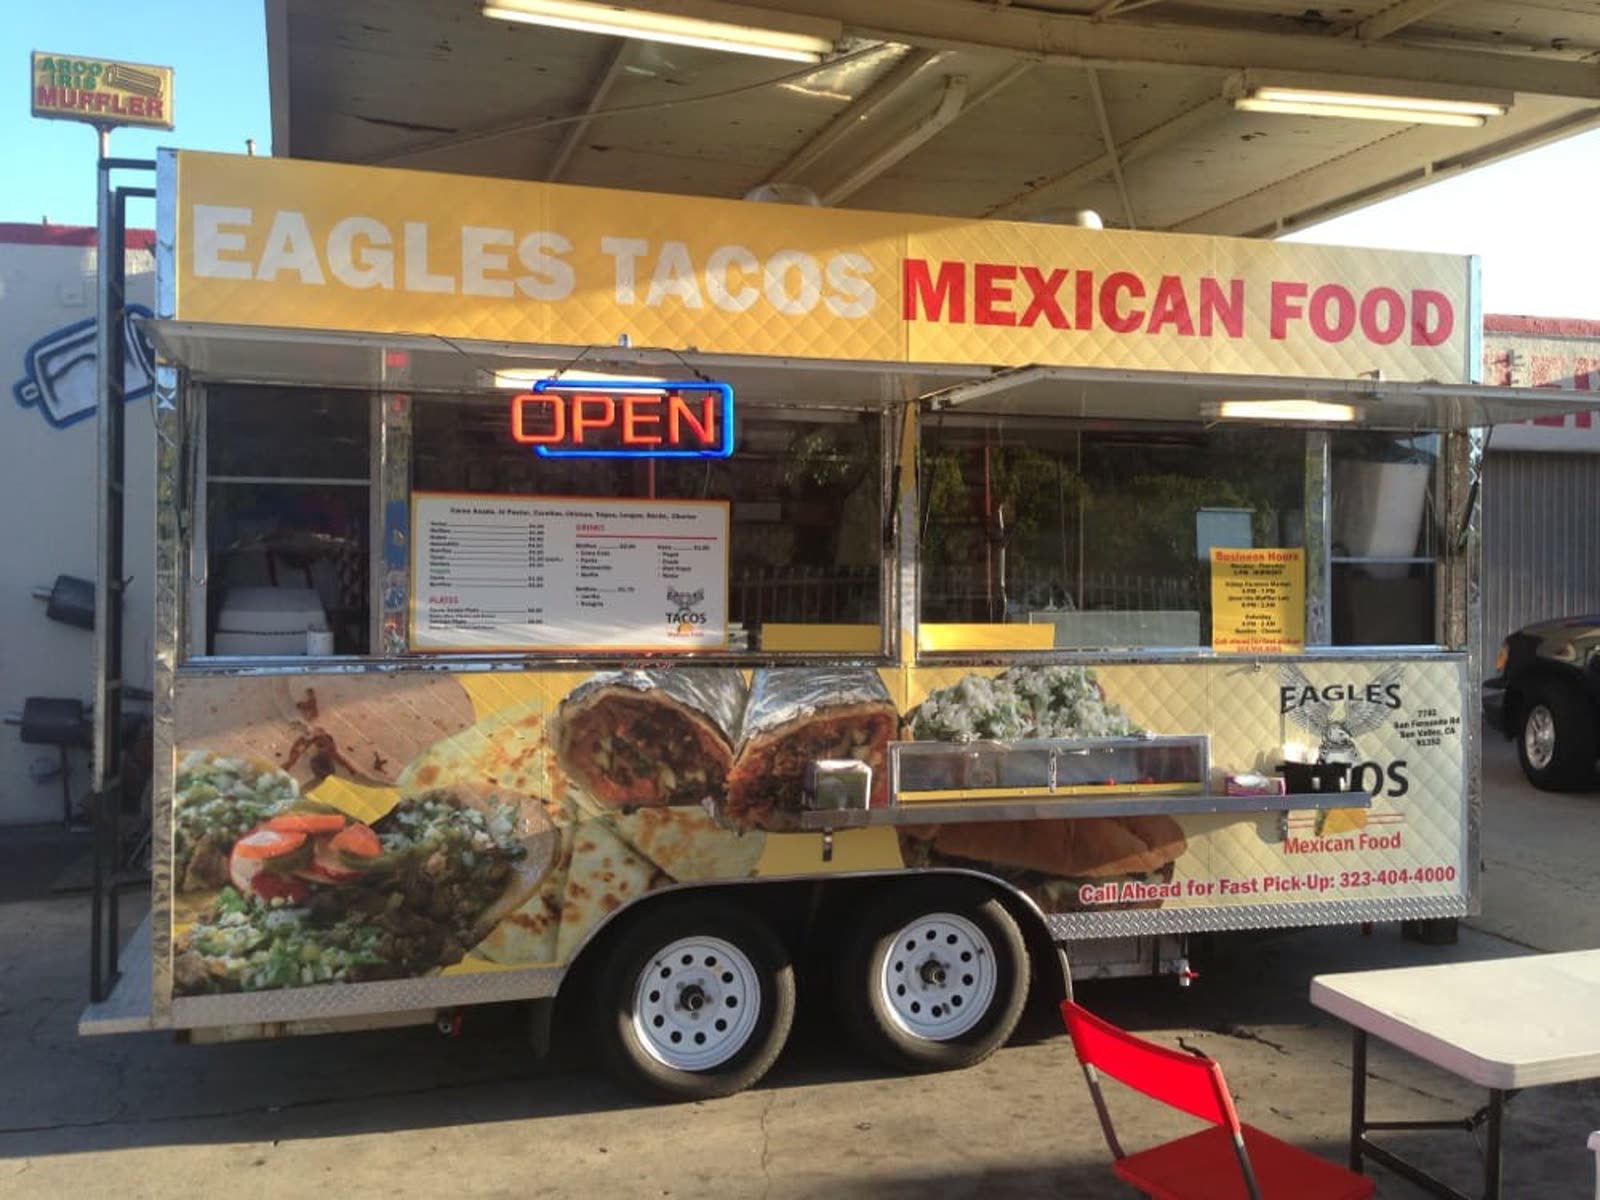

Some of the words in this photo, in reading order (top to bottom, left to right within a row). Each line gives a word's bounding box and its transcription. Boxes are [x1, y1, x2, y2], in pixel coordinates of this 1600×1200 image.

[37, 86, 164, 118] MUFFLER
[192, 204, 575, 301] EAGLES
[601, 236, 877, 319] TACOS
[903, 258, 1245, 339] MEXICAN
[1270, 281, 1455, 347] FOOD
[511, 393, 716, 446] OPEN
[1215, 551, 1265, 561] Business
[1268, 551, 1299, 561] Hours
[665, 612, 707, 624] TACOS
[1280, 684, 1403, 714] EAGLES
[1411, 717, 1447, 729] Fernando
[1449, 716, 1460, 725] Rd
[1444, 727, 1456, 736] CA
[1283, 835, 1355, 856] Mexican
[1359, 832, 1402, 850] Food
[1079, 882, 1117, 903] Call
[1122, 880, 1182, 900] Ahead
[1186, 880, 1215, 897] for
[1220, 877, 1258, 895] Fast
[1263, 872, 1335, 893] Pick-Up:
[1339, 865, 1456, 888] 323-404-4000
